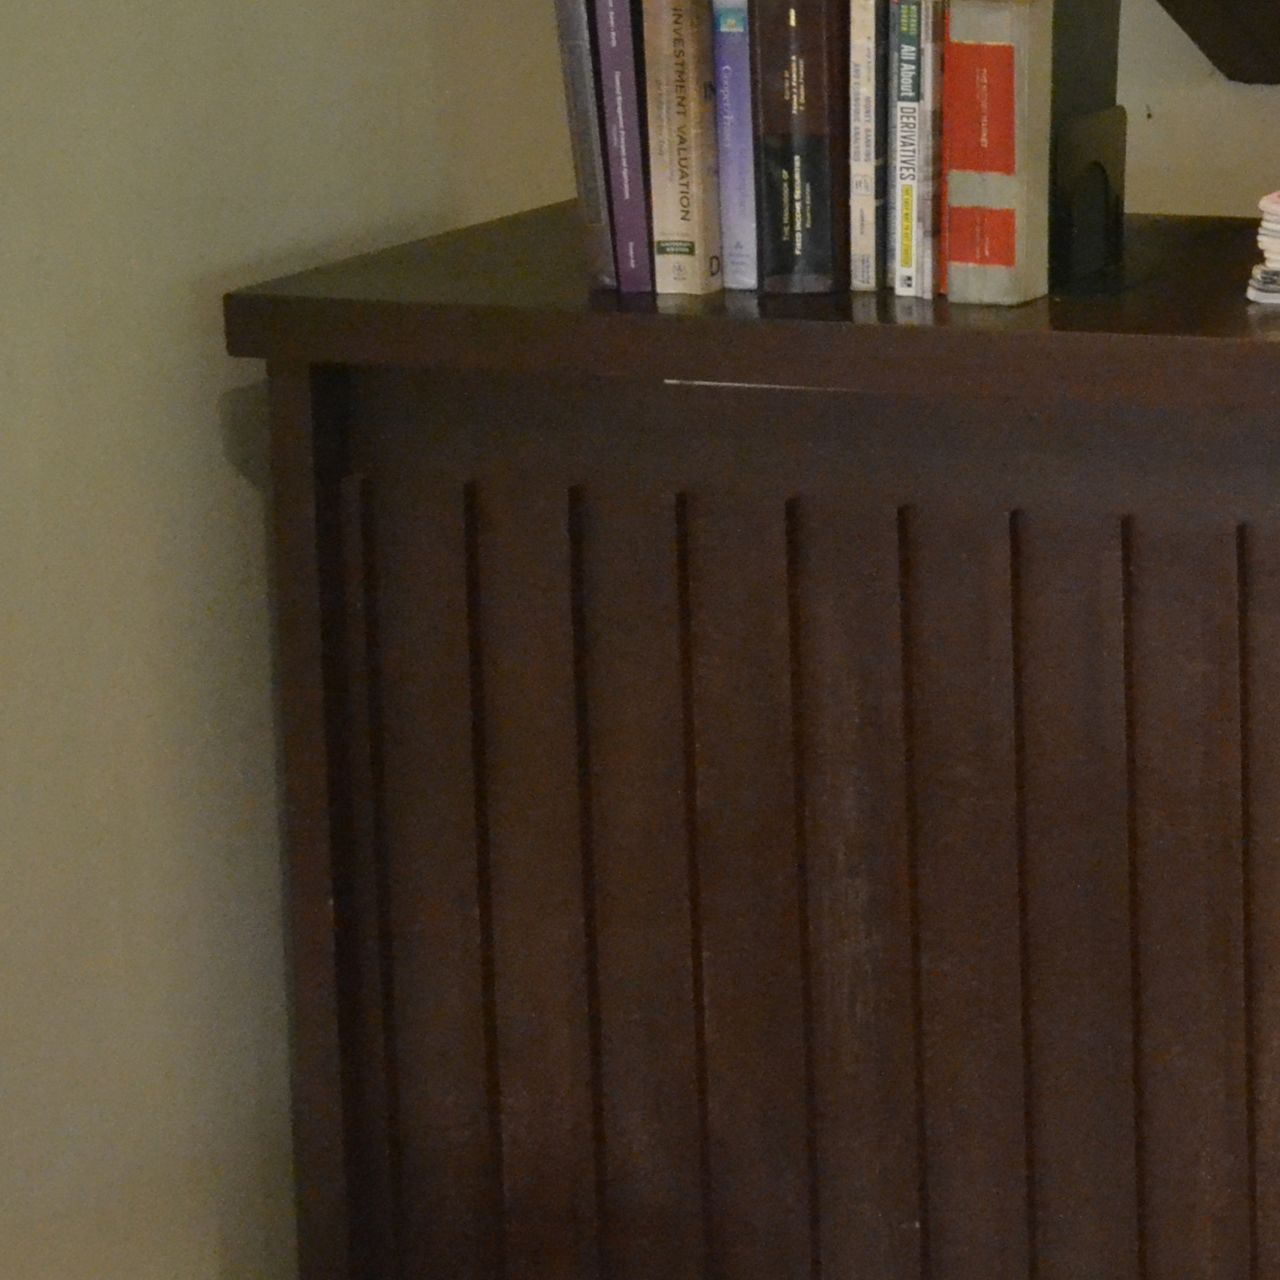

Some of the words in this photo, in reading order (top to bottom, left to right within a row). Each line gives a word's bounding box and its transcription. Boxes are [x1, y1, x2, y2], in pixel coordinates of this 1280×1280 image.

[672, 7, 687, 116] INVESTMENT
[900, 44, 917, 60] All
[900, 63, 916, 97] About
[676, 125, 690, 222] VALUATION
[900, 106, 917, 181] DERIVATIVES
